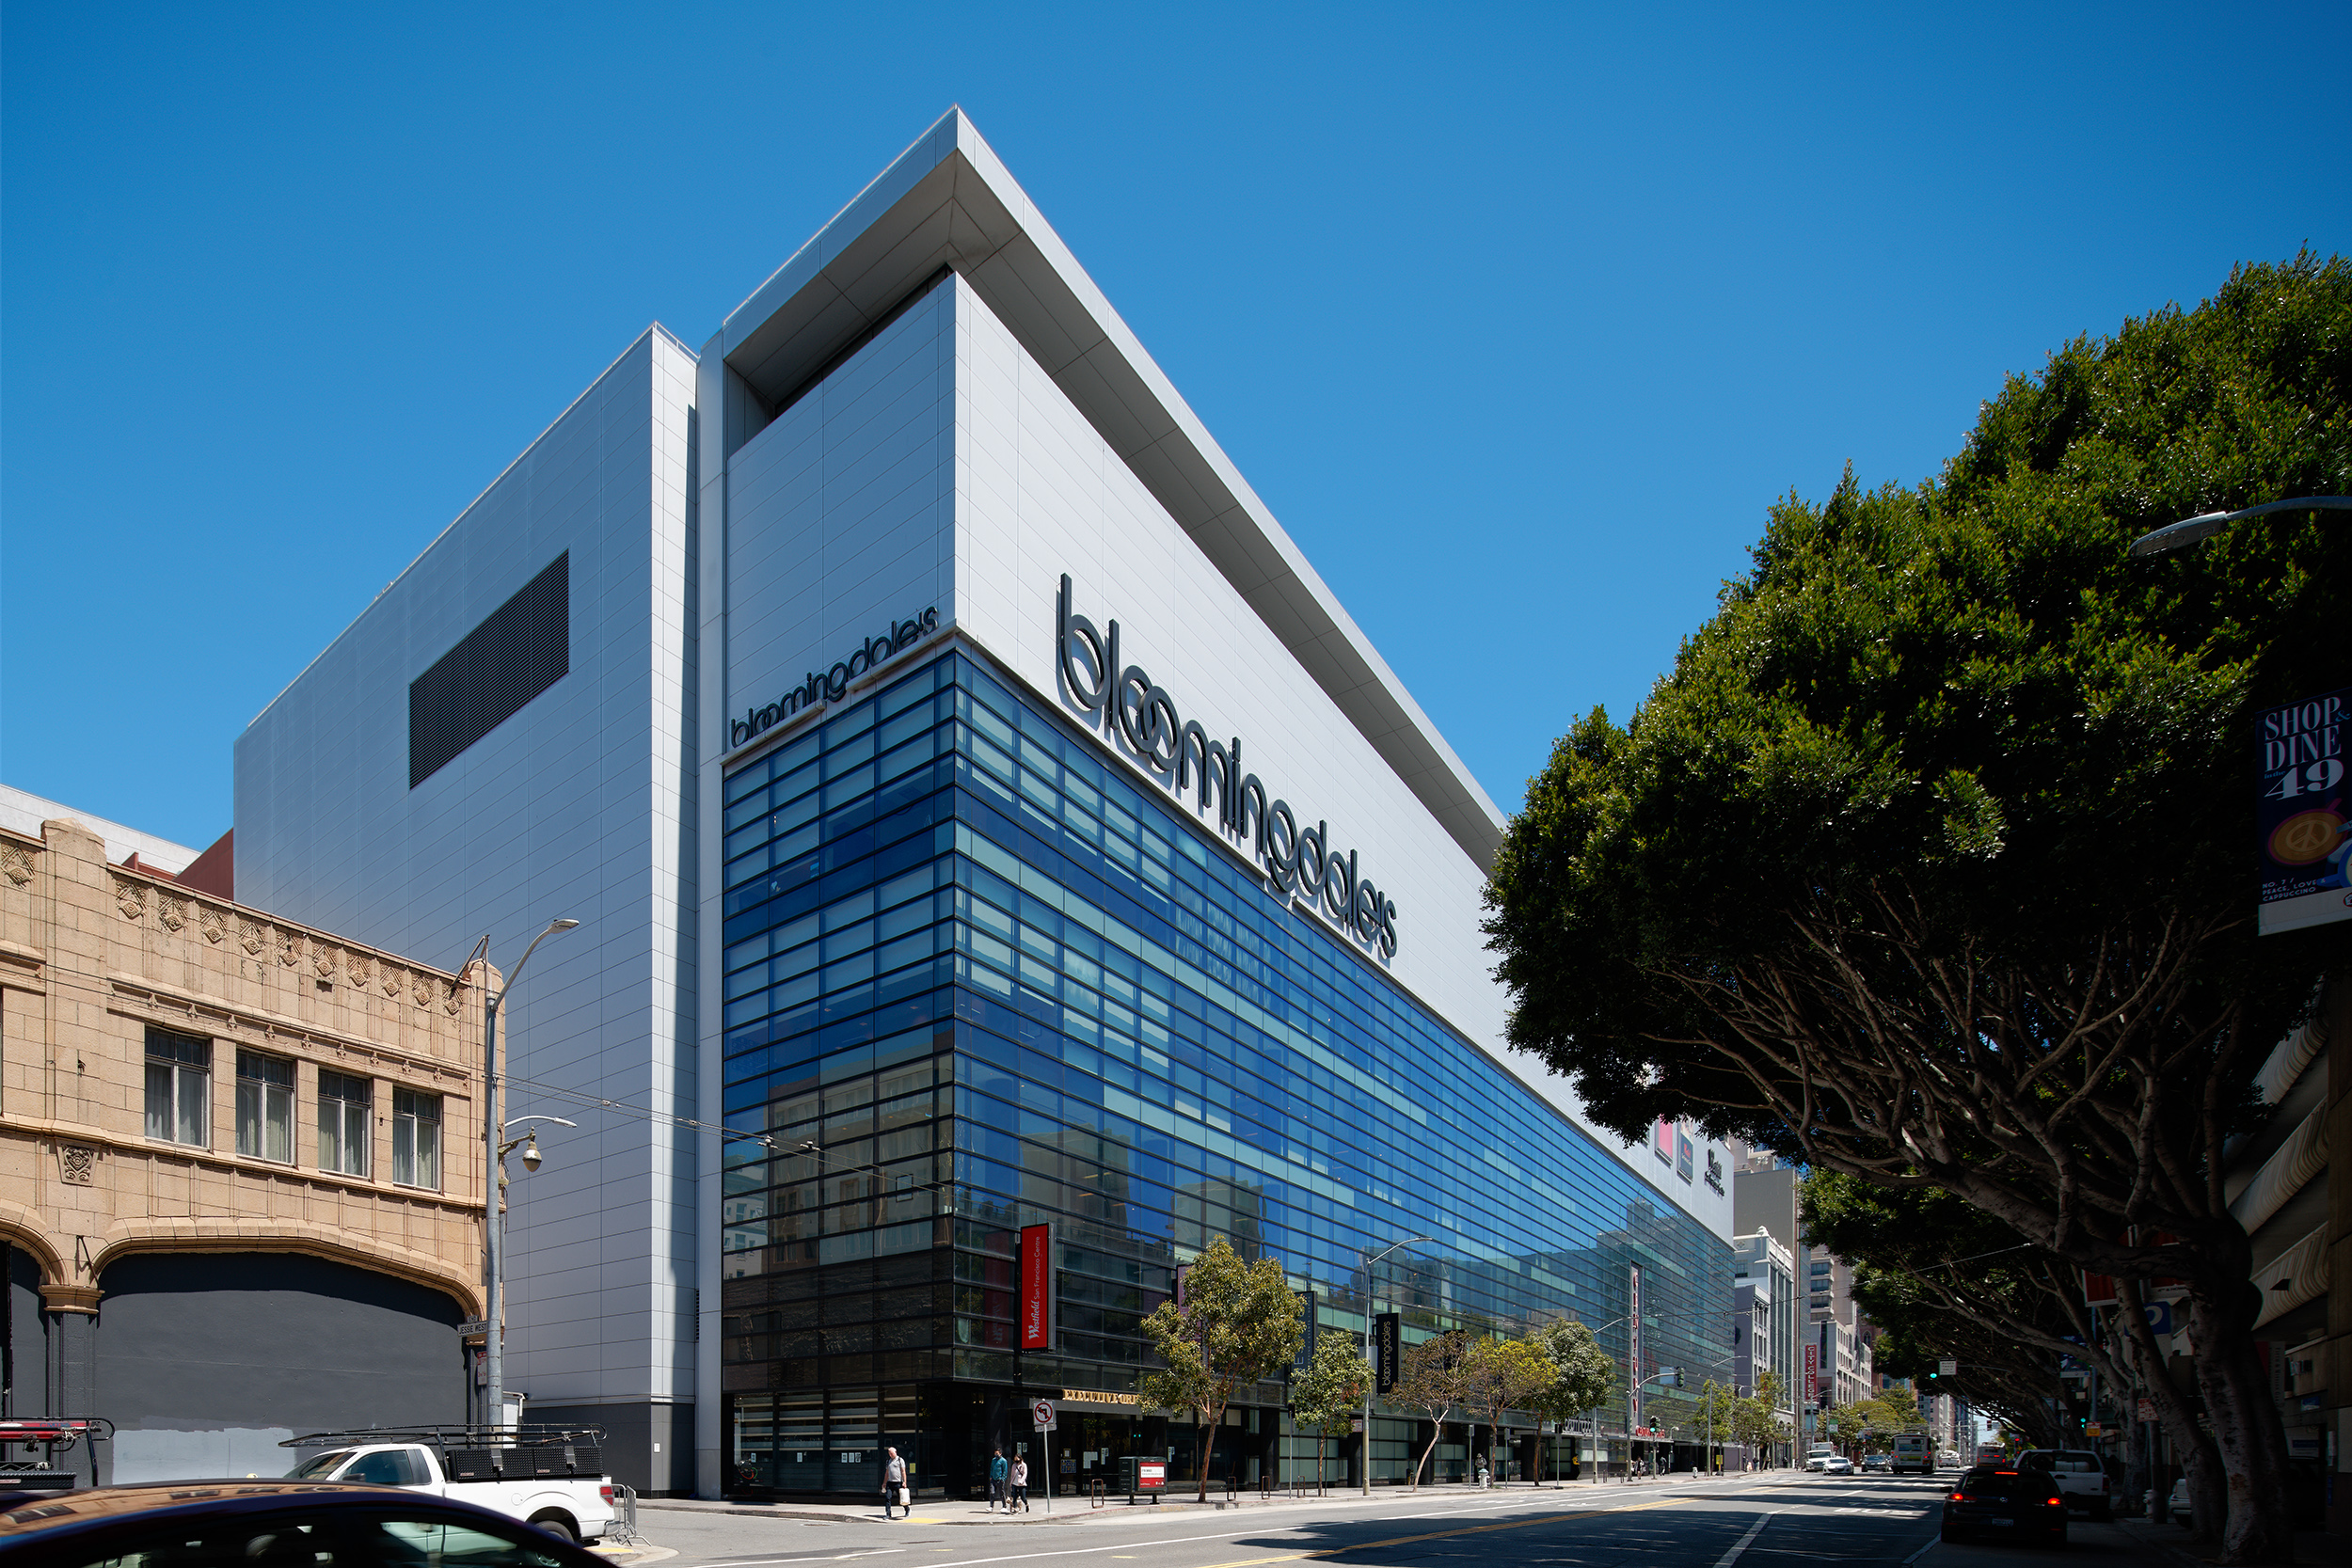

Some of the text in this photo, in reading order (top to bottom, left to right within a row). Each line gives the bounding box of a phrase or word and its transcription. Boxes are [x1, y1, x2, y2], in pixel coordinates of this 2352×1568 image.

[2265, 696, 2351, 741] SHOP &
[2264, 724, 2342, 772] DINE
[2264, 758, 2344, 800] 49
[2262, 881, 2278, 890] NO.
[2262, 885, 2290, 895] PEACE,
[2293, 879, 2317, 890] LOVE
[2262, 886, 2317, 902] CAPPUCCINO
[1028, 1300, 1041, 1339] Westfield
[1062, 1389, 1119, 1403] EXECUTIVE
